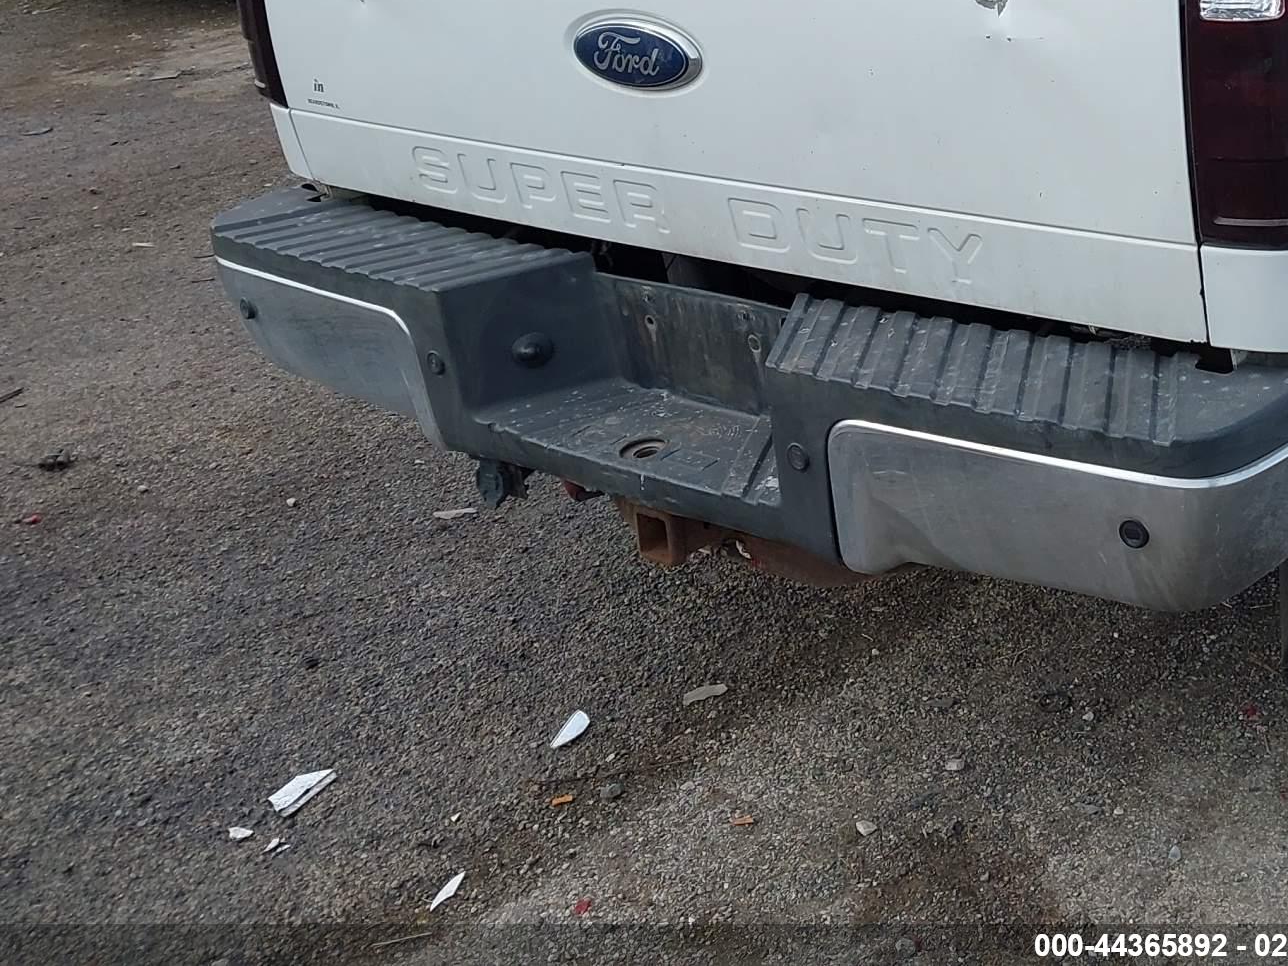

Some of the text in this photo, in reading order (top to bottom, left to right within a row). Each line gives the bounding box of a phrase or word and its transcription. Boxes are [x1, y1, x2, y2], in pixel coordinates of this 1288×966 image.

[593, 31, 660, 76] Ford
[411, 144, 984, 285] SUPER DUTY
